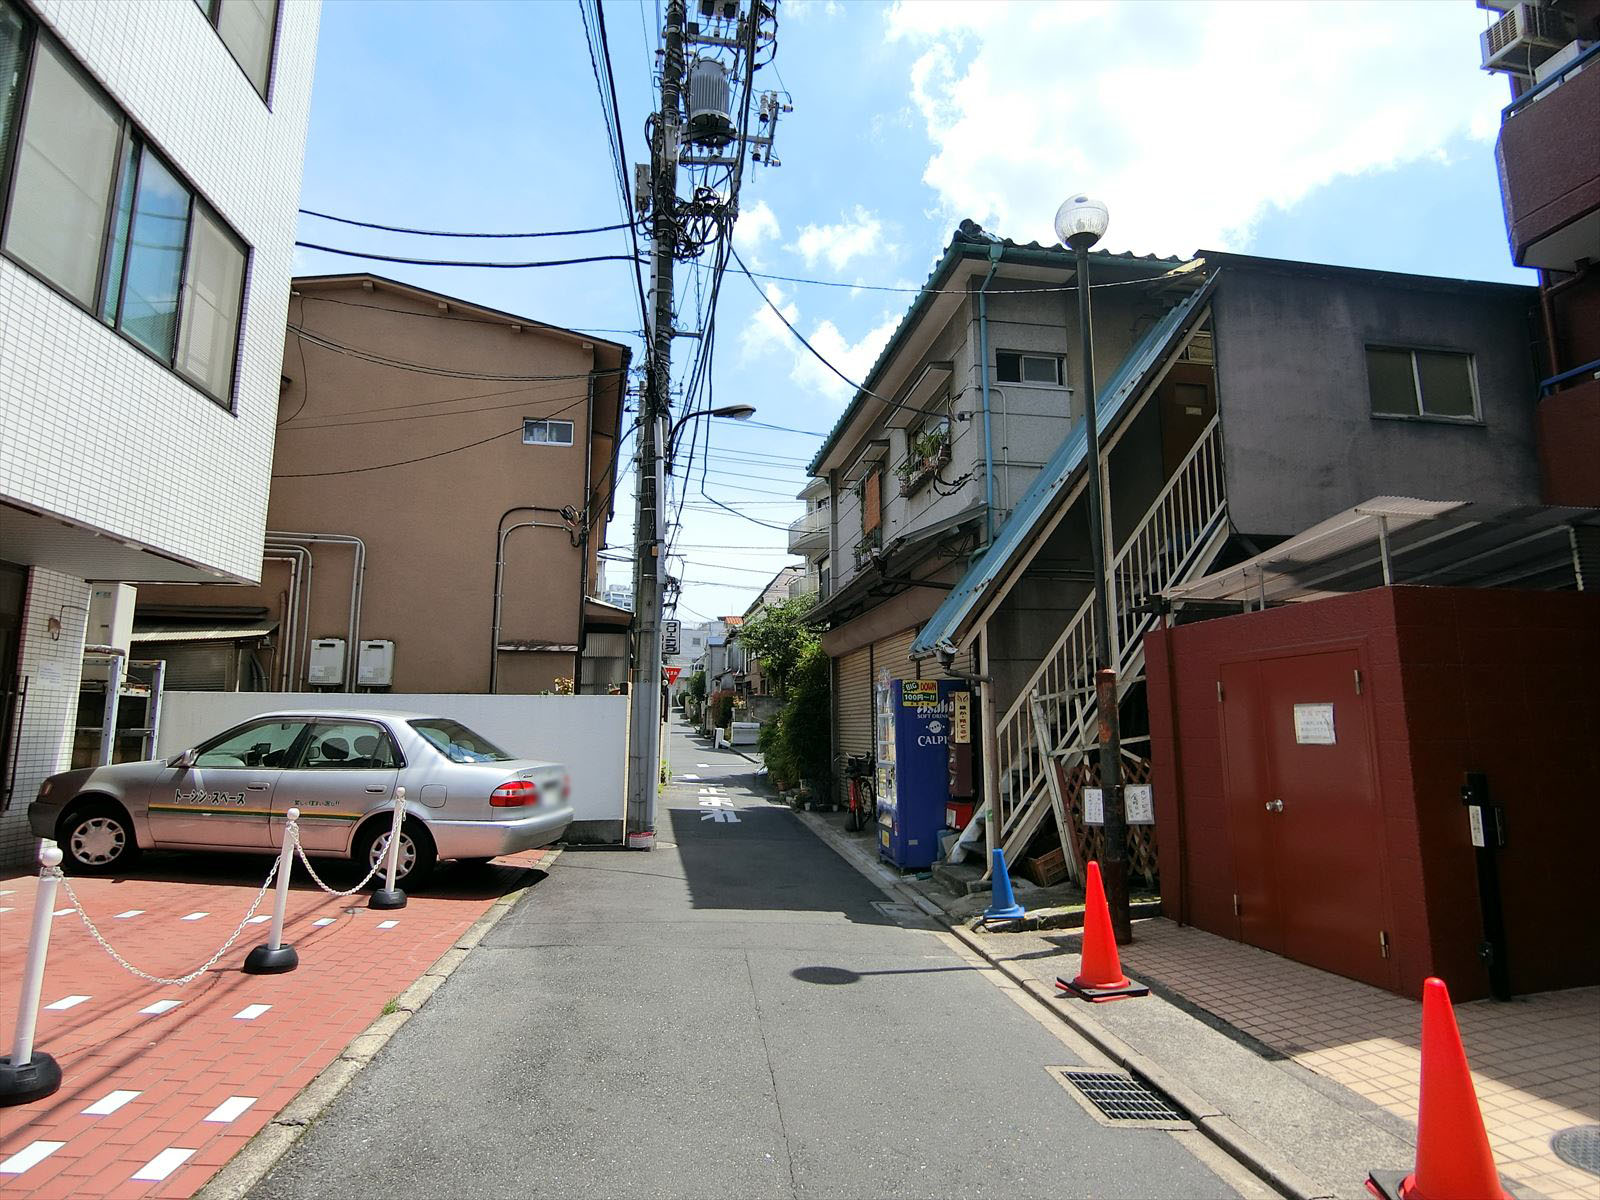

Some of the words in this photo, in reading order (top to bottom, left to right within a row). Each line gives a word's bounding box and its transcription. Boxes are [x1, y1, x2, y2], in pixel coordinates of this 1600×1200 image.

[905, 682, 918, 692] BIG
[920, 682, 936, 691] DOWN
[697, 786, 742, 823] 止まれ
